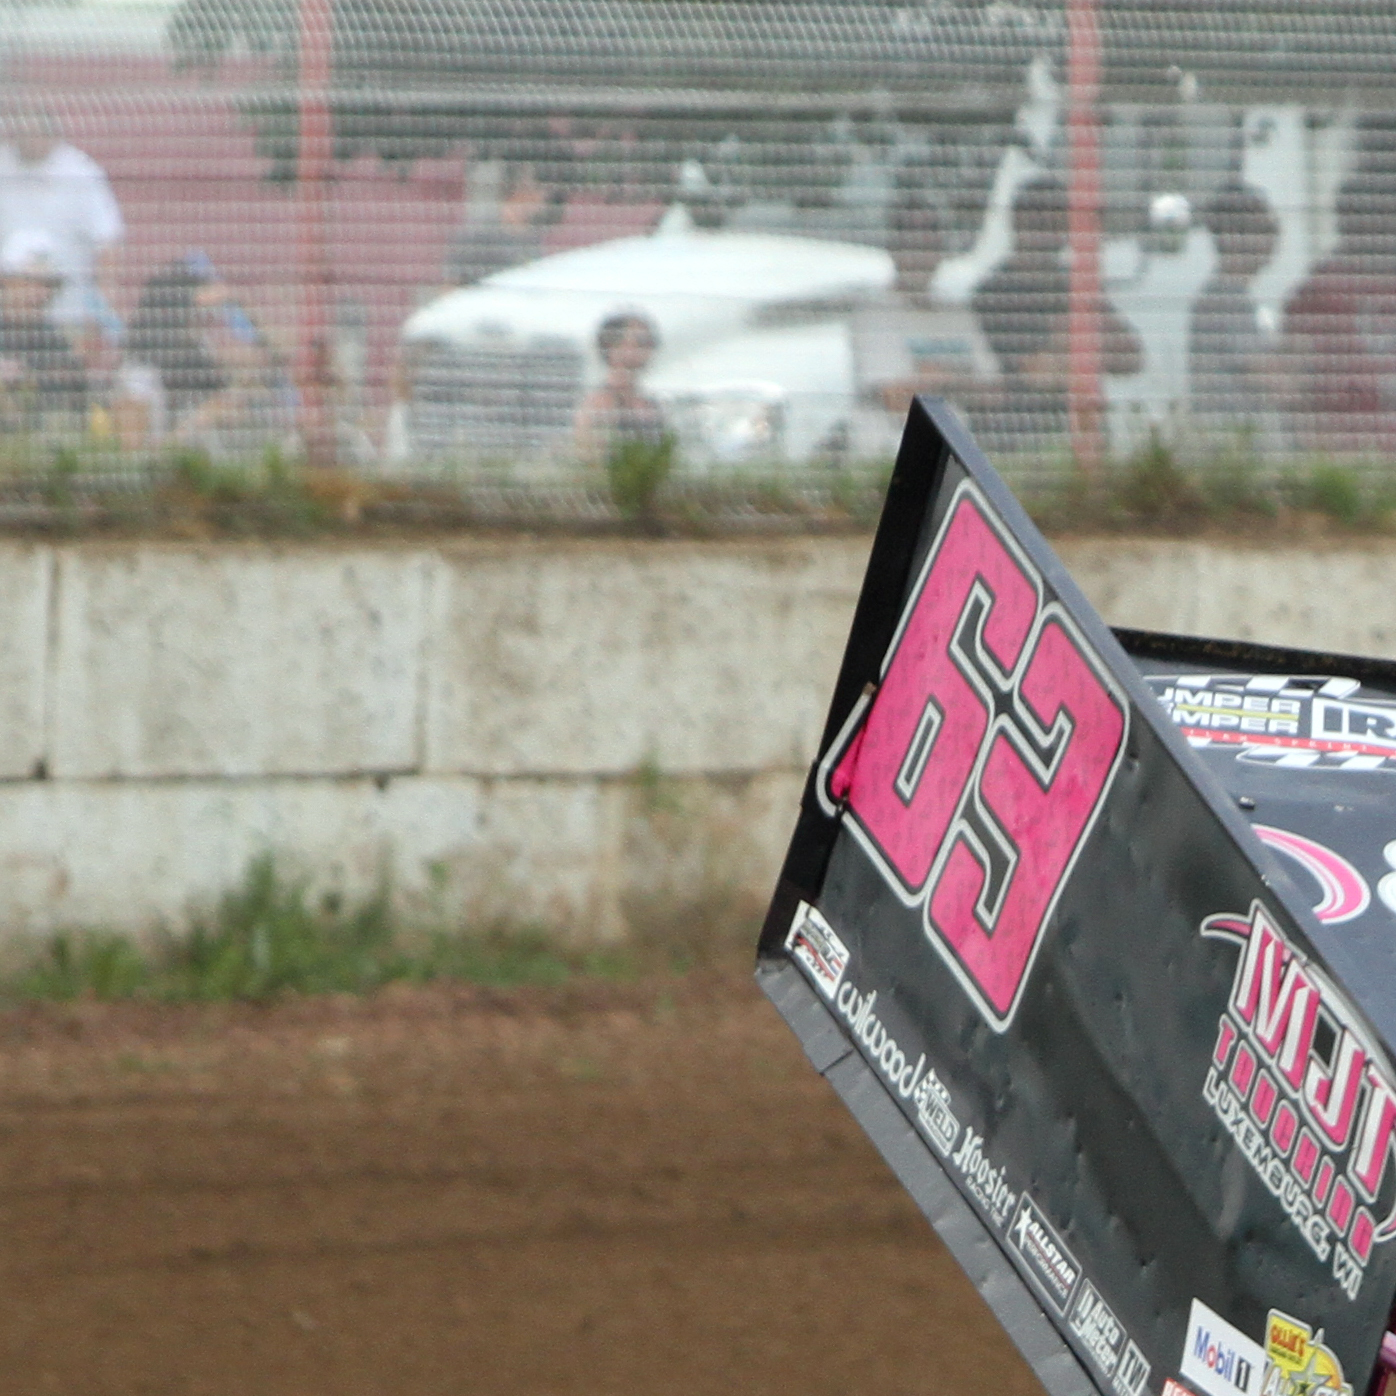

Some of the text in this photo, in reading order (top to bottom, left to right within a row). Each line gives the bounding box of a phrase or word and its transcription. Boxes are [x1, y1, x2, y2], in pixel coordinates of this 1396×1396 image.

[1160, 688, 1300, 714] UMPER
[816, 478, 1130, 1032] 63
[838, 981, 926, 1098] wilwood
[925, 1092, 957, 1141] WELD
[1214, 1014, 1374, 1266] TRUCKING
[953, 1126, 1017, 1218] Hoosier
[1029, 1222, 1076, 1282] ALLSTAR
[1333, 1243, 1363, 1299] WI
[1079, 1320, 1118, 1376] Meter
[1092, 1303, 1120, 1346] Auto
[1194, 1326, 1235, 1382] Mobil
[1234, 1357, 1251, 1393] 1
